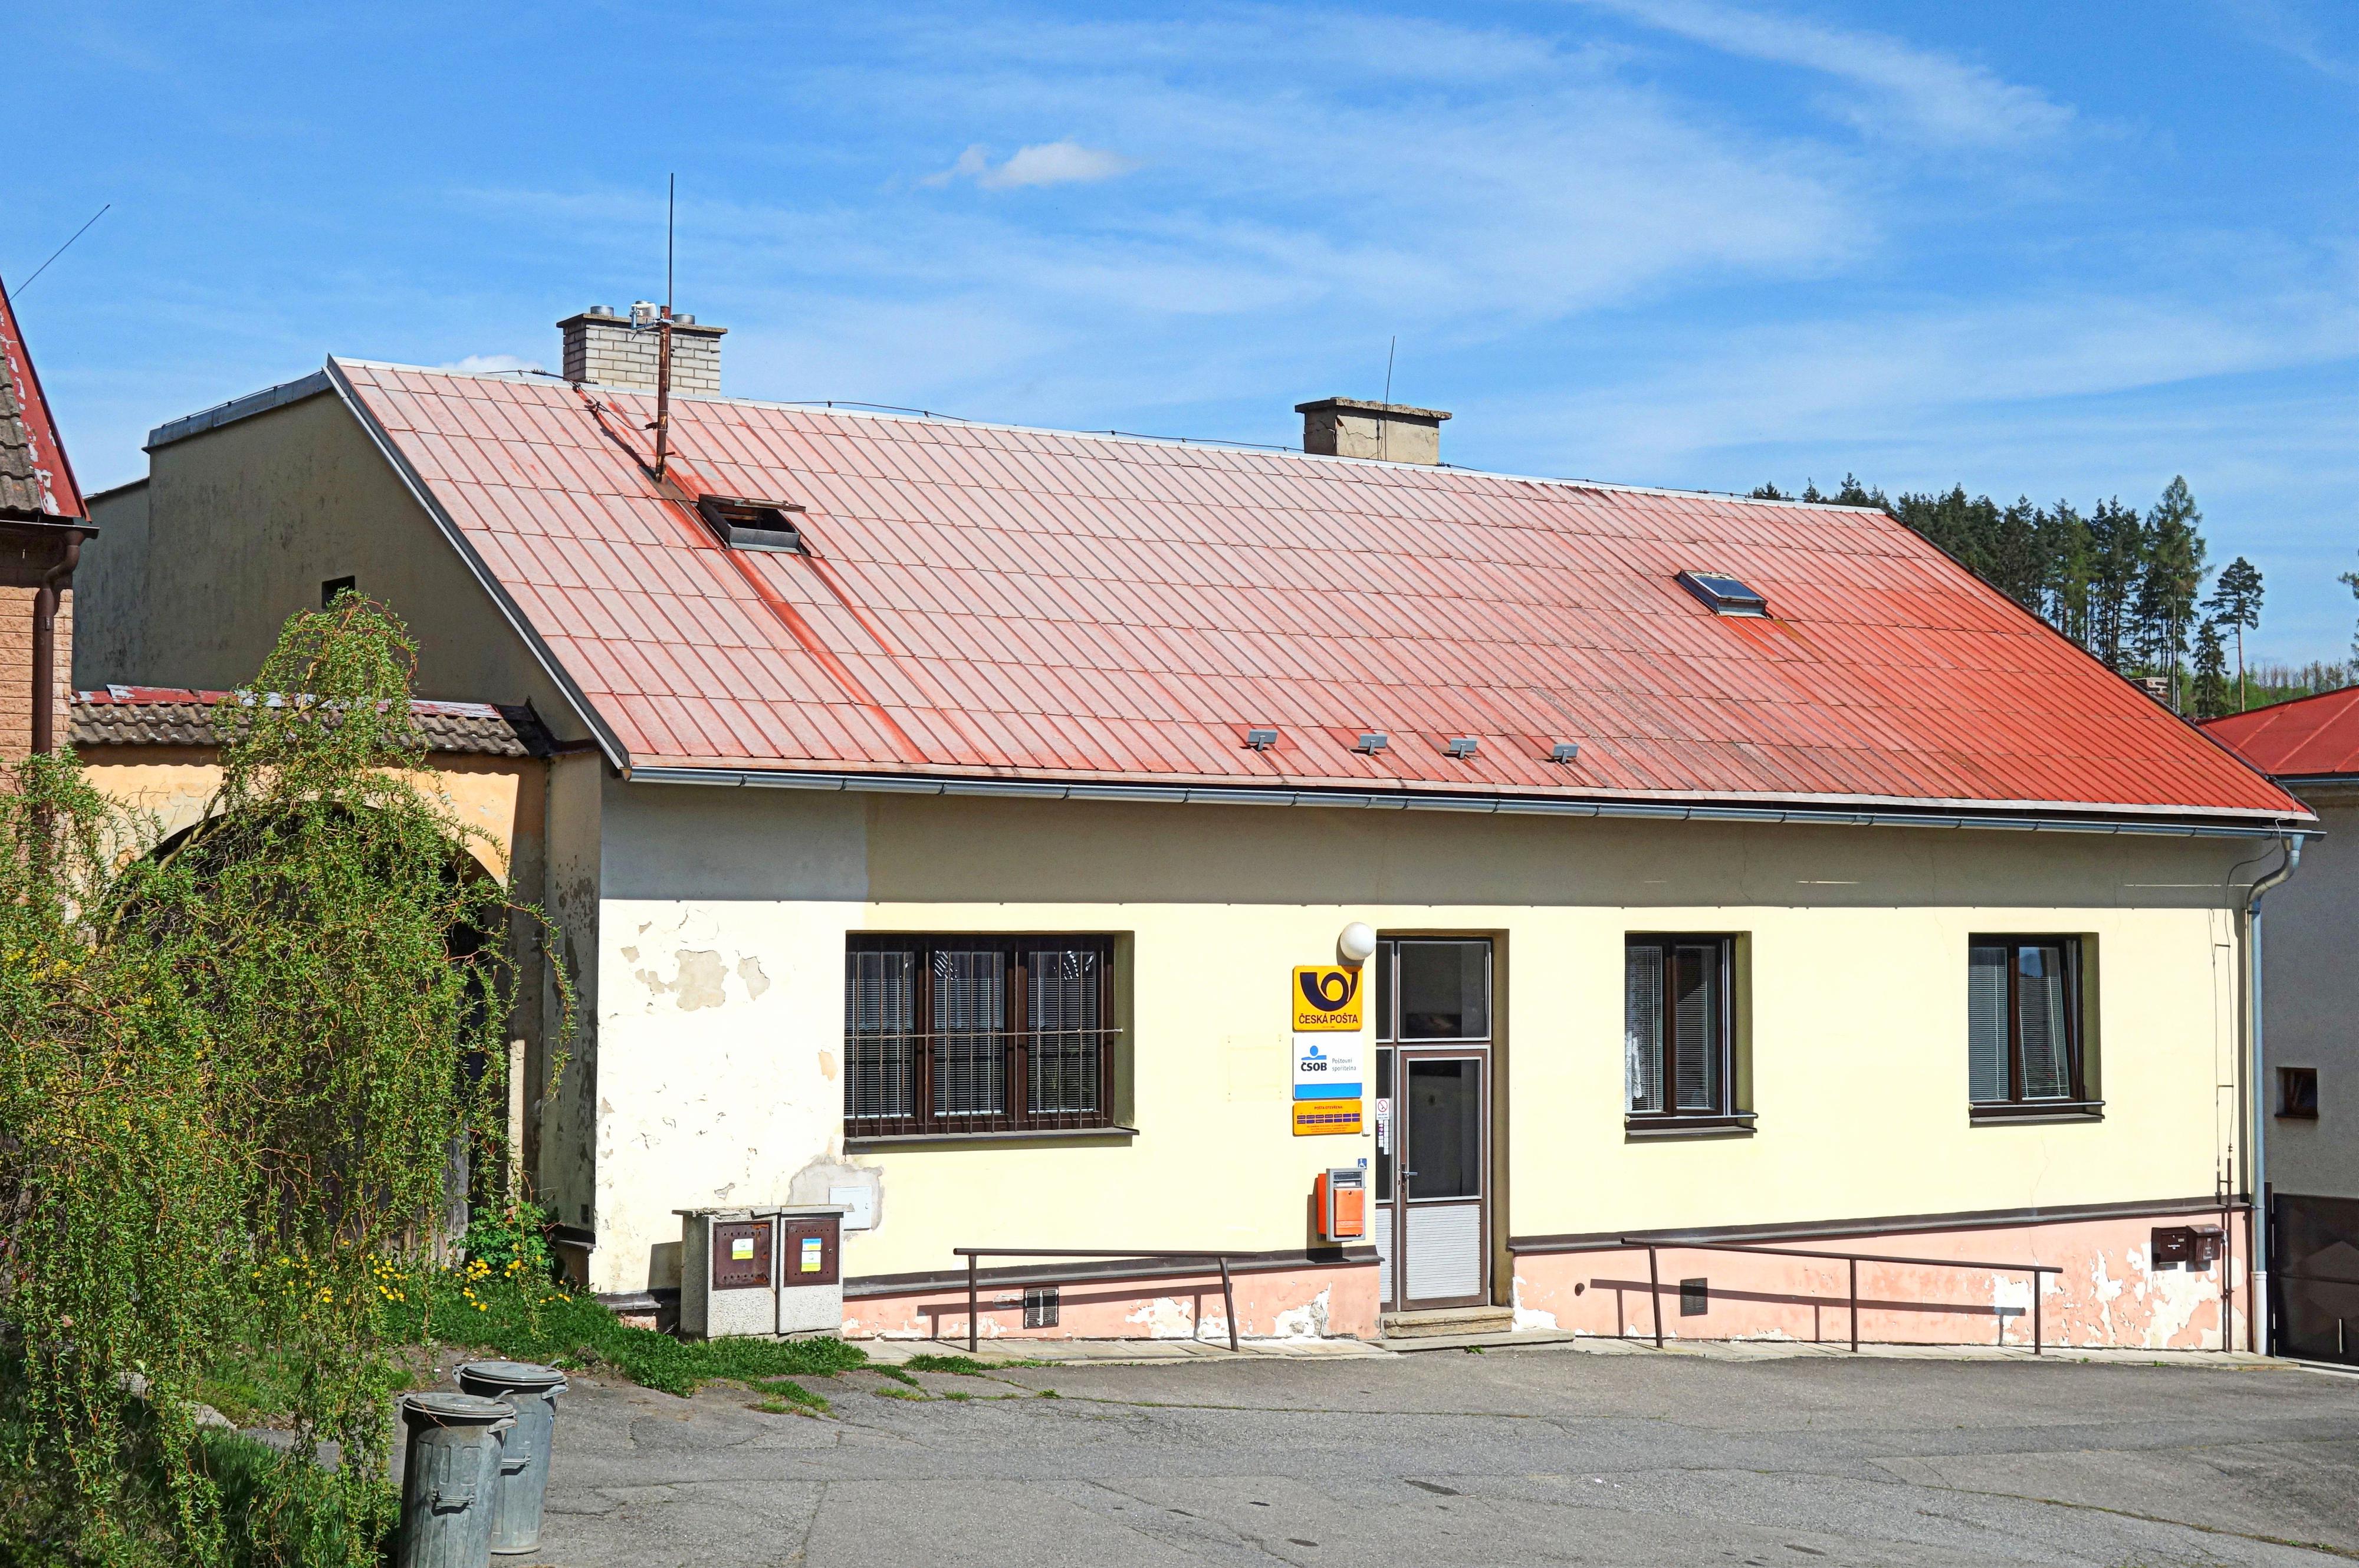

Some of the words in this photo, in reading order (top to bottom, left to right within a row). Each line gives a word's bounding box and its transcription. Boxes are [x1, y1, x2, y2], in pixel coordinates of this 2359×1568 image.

[1299, 1013, 1328, 1024] ČESKÁ
[1330, 1013, 1358, 1024] POŠTA
[1300, 1062, 1327, 1071] ČSOB
